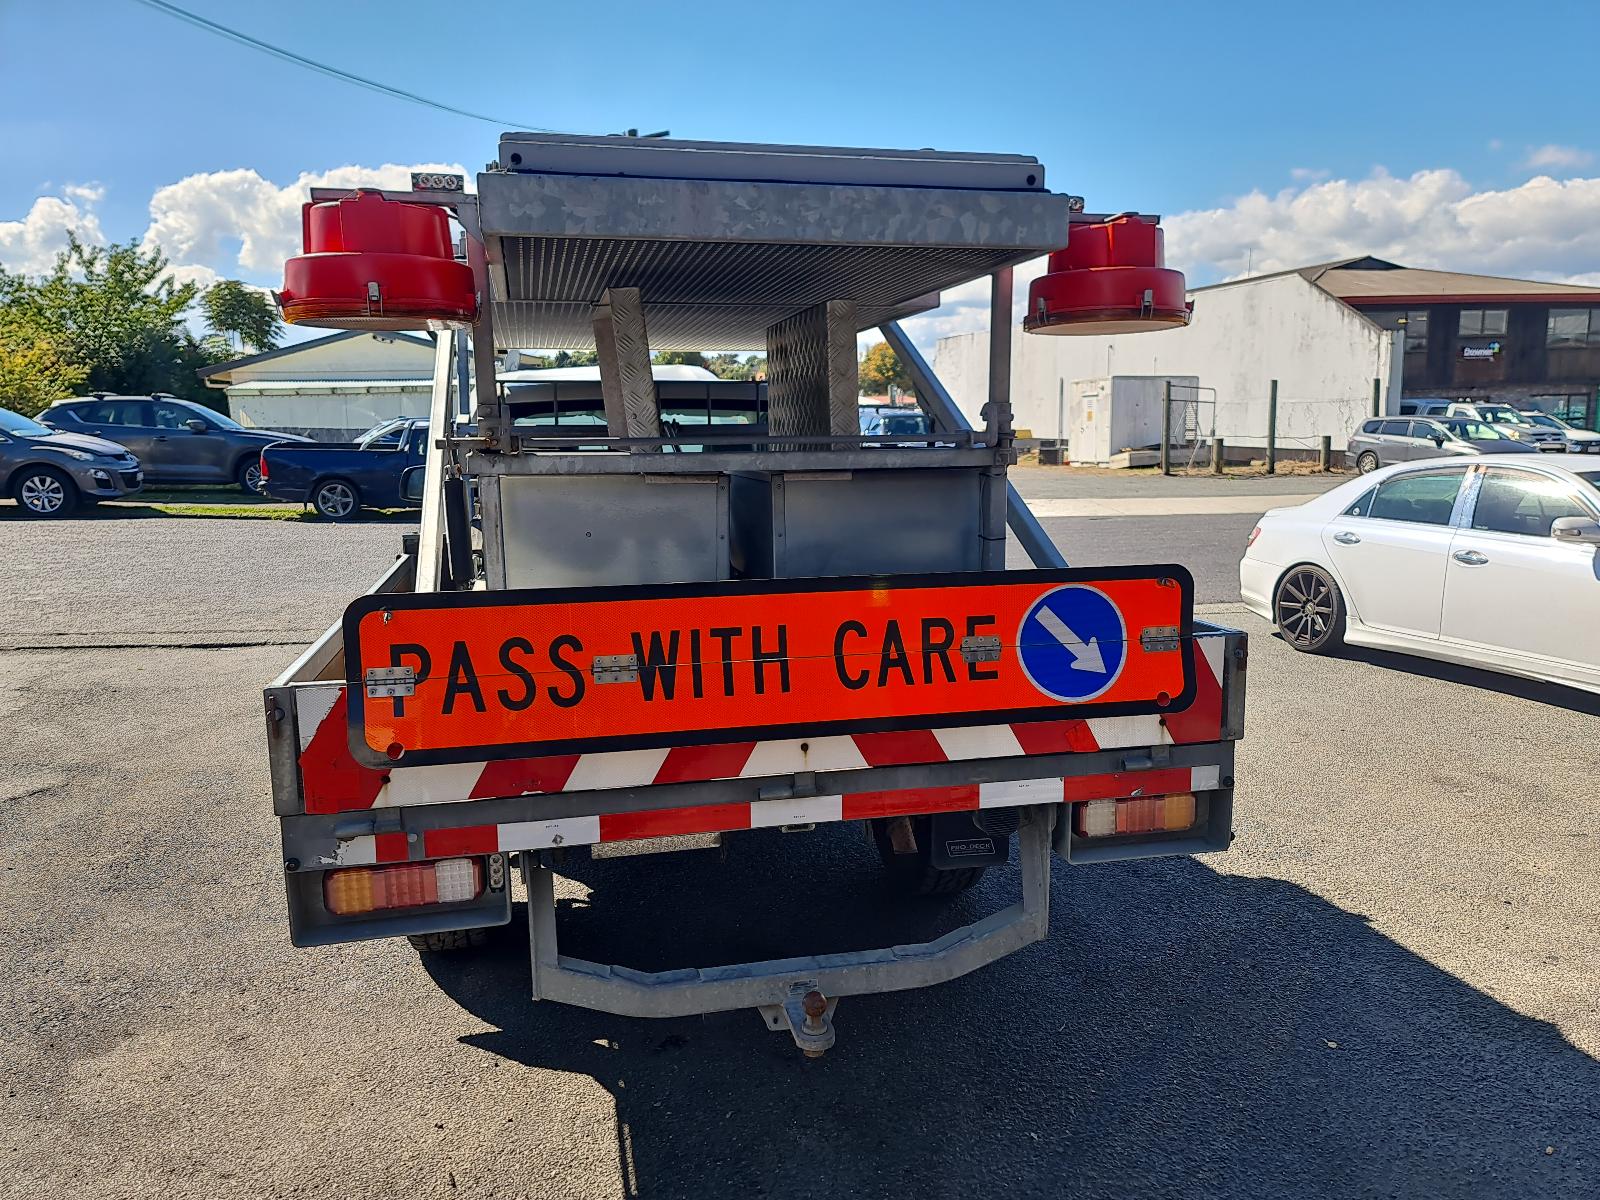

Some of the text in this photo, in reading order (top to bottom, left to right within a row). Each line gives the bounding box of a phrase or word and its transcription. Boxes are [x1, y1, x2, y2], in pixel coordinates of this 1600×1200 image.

[390, 615, 999, 718] PASS WITH CARE
